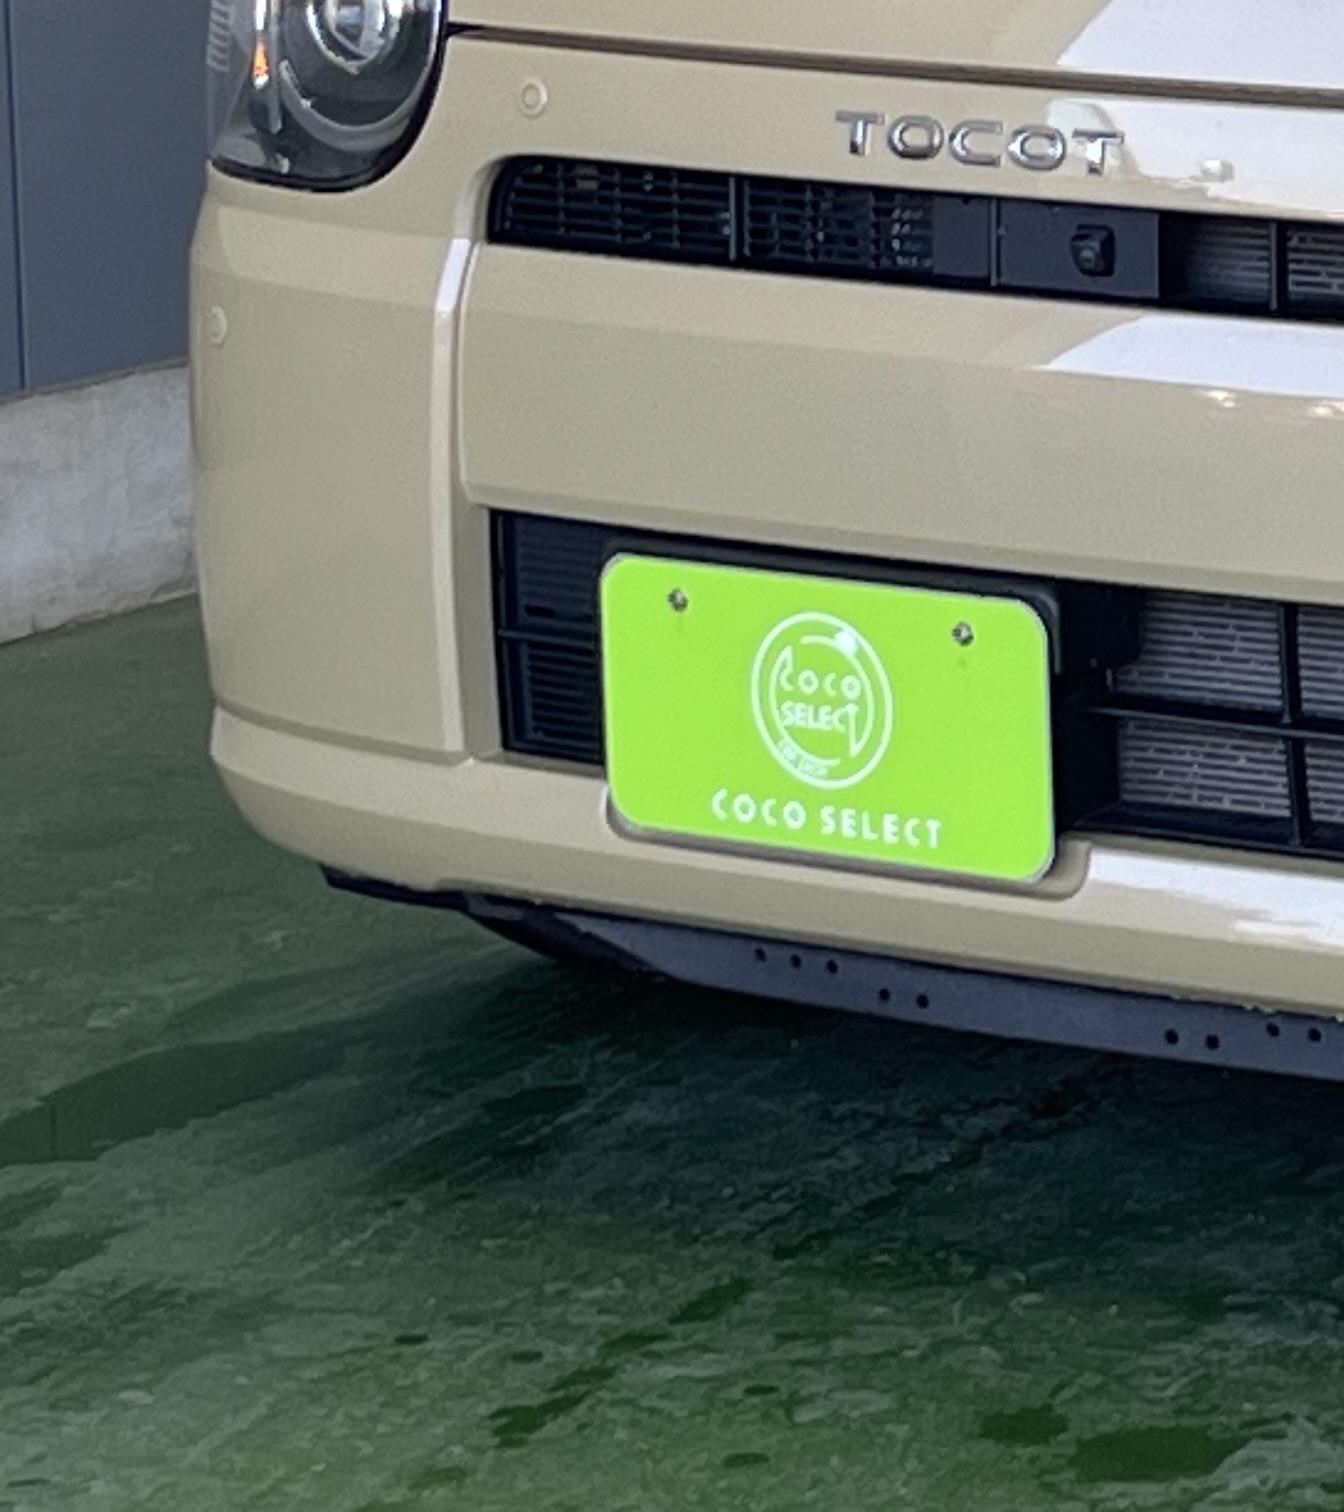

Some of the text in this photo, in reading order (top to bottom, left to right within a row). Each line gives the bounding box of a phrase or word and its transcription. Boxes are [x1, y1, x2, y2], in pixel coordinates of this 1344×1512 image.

[835, 110, 1124, 176] TOCOT
[780, 647, 862, 699] COCO
[711, 788, 942, 848] COCO SELECT
